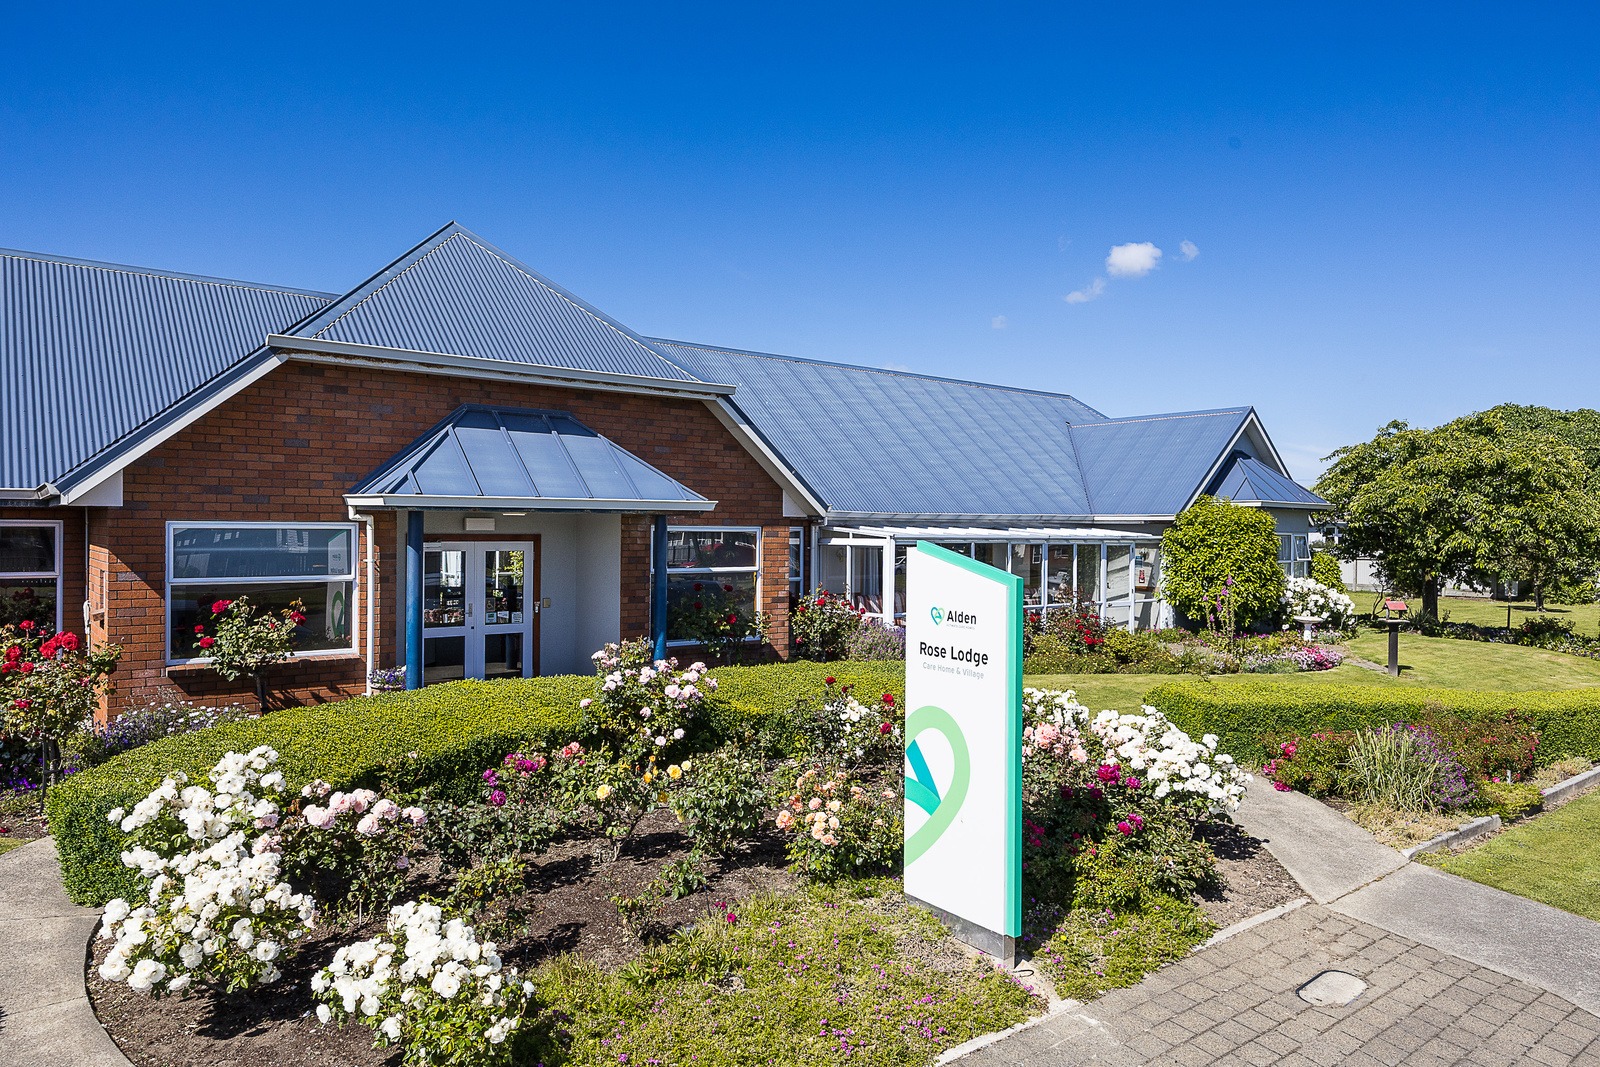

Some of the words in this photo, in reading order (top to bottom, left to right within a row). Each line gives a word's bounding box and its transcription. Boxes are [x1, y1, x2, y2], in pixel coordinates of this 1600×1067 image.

[947, 611, 977, 624] Alden
[920, 642, 946, 658] Rose
[950, 646, 988, 667] Lodge
[922, 662, 936, 671] Care
[938, 664, 954, 674] Home
[962, 668, 984, 680] Village
